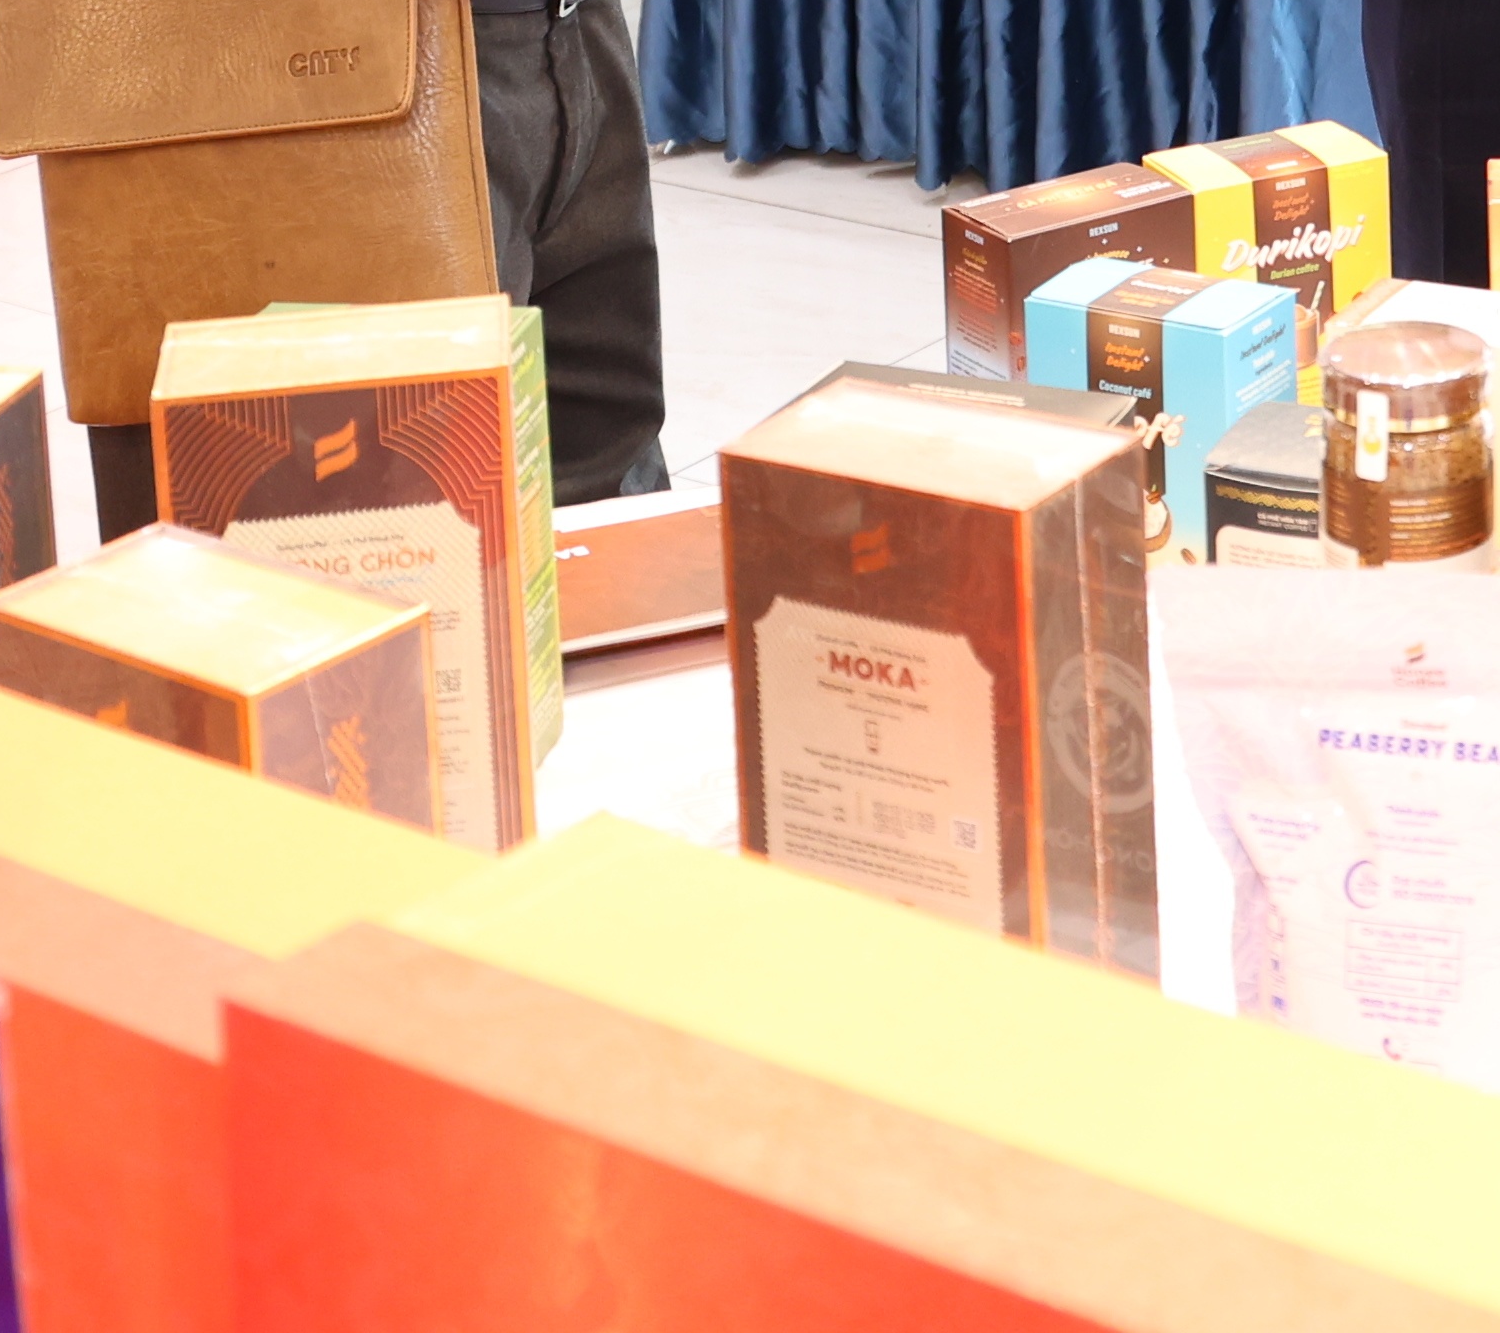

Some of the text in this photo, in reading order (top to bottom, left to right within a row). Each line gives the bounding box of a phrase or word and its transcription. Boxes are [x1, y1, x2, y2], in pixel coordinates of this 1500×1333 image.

[1220, 213, 1366, 273] Durikopi
[1269, 263, 1320, 281] Durian coffee
[1098, 379, 1152, 399] Coconut café
[828, 649, 917, 693] MOKA
[1317, 727, 1445, 761] PEABERRY
